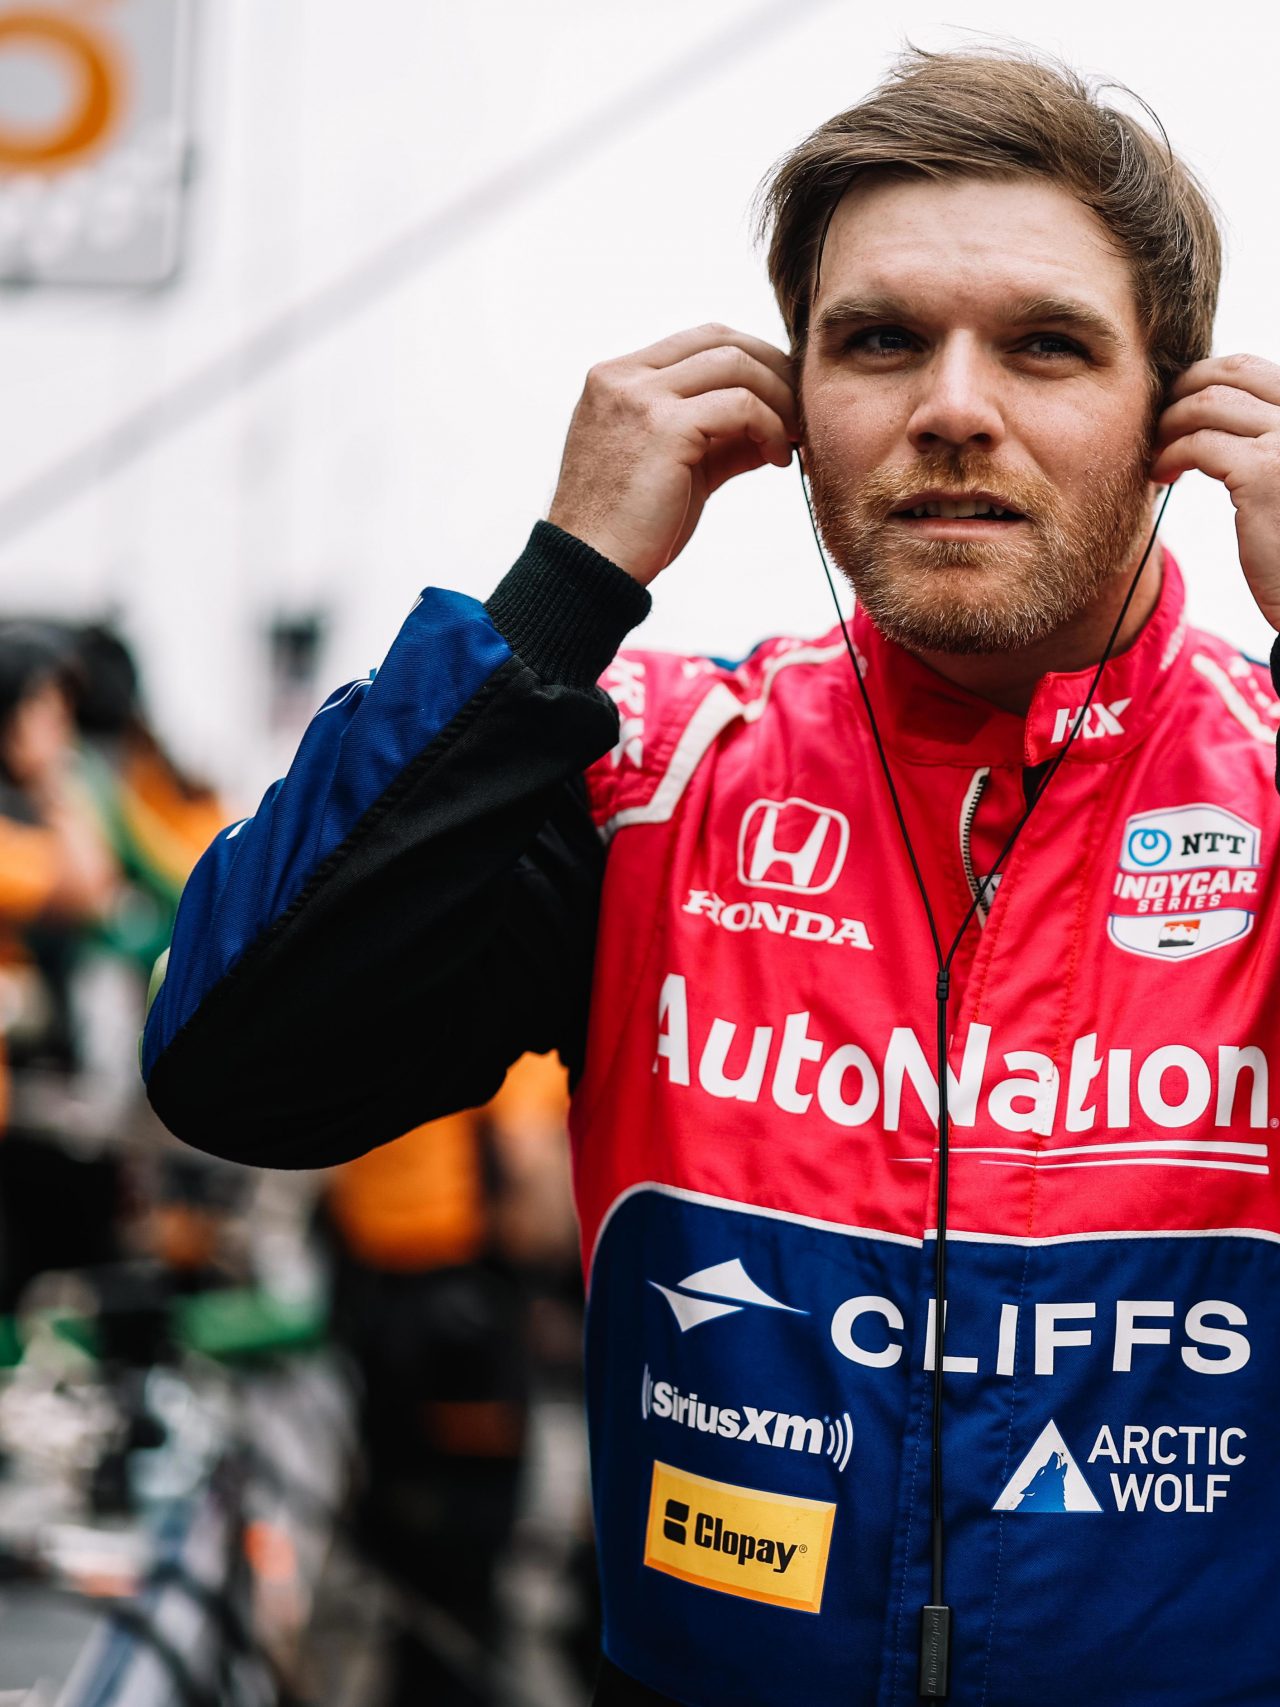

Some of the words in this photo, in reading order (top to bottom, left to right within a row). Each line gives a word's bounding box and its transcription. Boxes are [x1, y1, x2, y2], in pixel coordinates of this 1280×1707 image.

[1051, 697, 1132, 743] HRX
[1180, 832, 1246, 856] NTT
[1113, 870, 1257, 900] INDYCAR
[1136, 894, 1222, 913] SERIES
[681, 889, 875, 950] HONDA
[652, 973, 1269, 1137] AutoNation
[830, 1295, 1251, 1377] CLIFFS
[1086, 1424, 1248, 1466] ARCTIC
[1109, 1472, 1231, 1513] WOLF
[694, 1512, 799, 1574] Clopay
